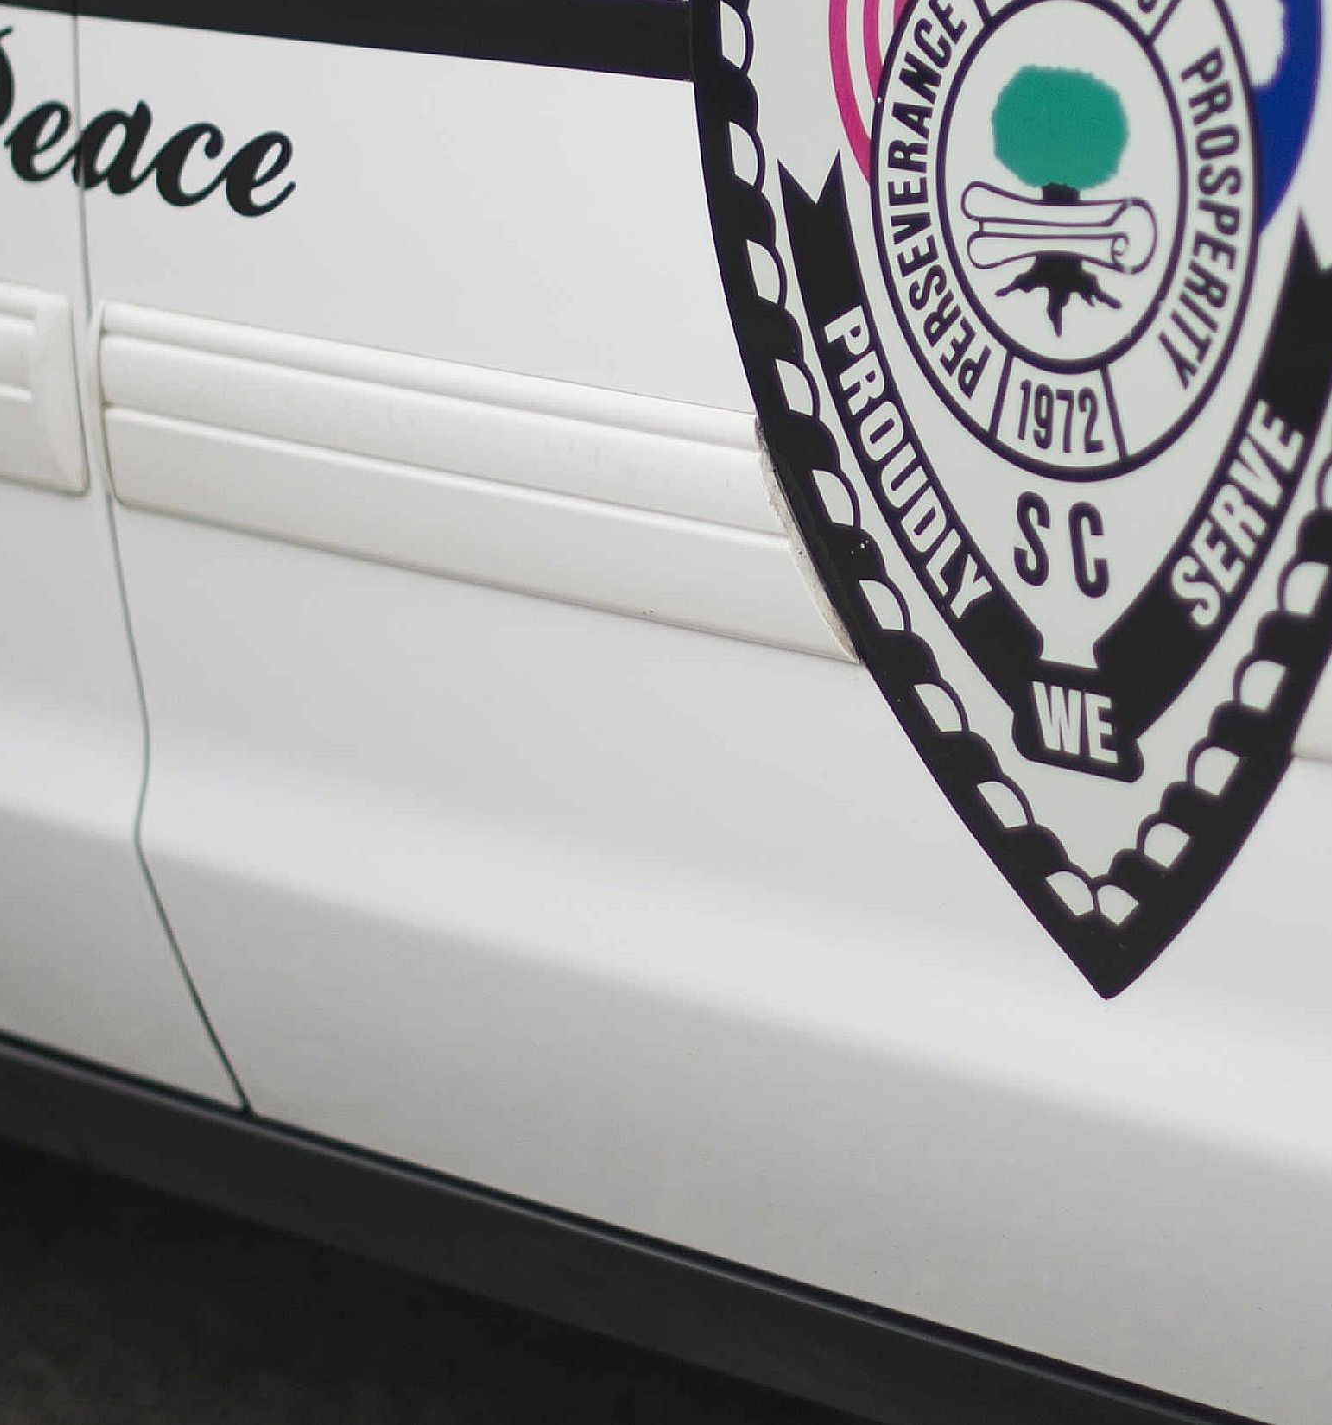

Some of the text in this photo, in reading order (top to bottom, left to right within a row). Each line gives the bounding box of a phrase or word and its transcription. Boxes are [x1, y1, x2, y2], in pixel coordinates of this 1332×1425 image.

[1158, 46, 1243, 391] PROSPERITY
[824, 305, 992, 619] PROUDLY
[1017, 382, 1105, 454] 1972
[1013, 492, 1109, 599] S C
[1172, 399, 1305, 628] SERVE
[1033, 679, 1119, 765] WE
